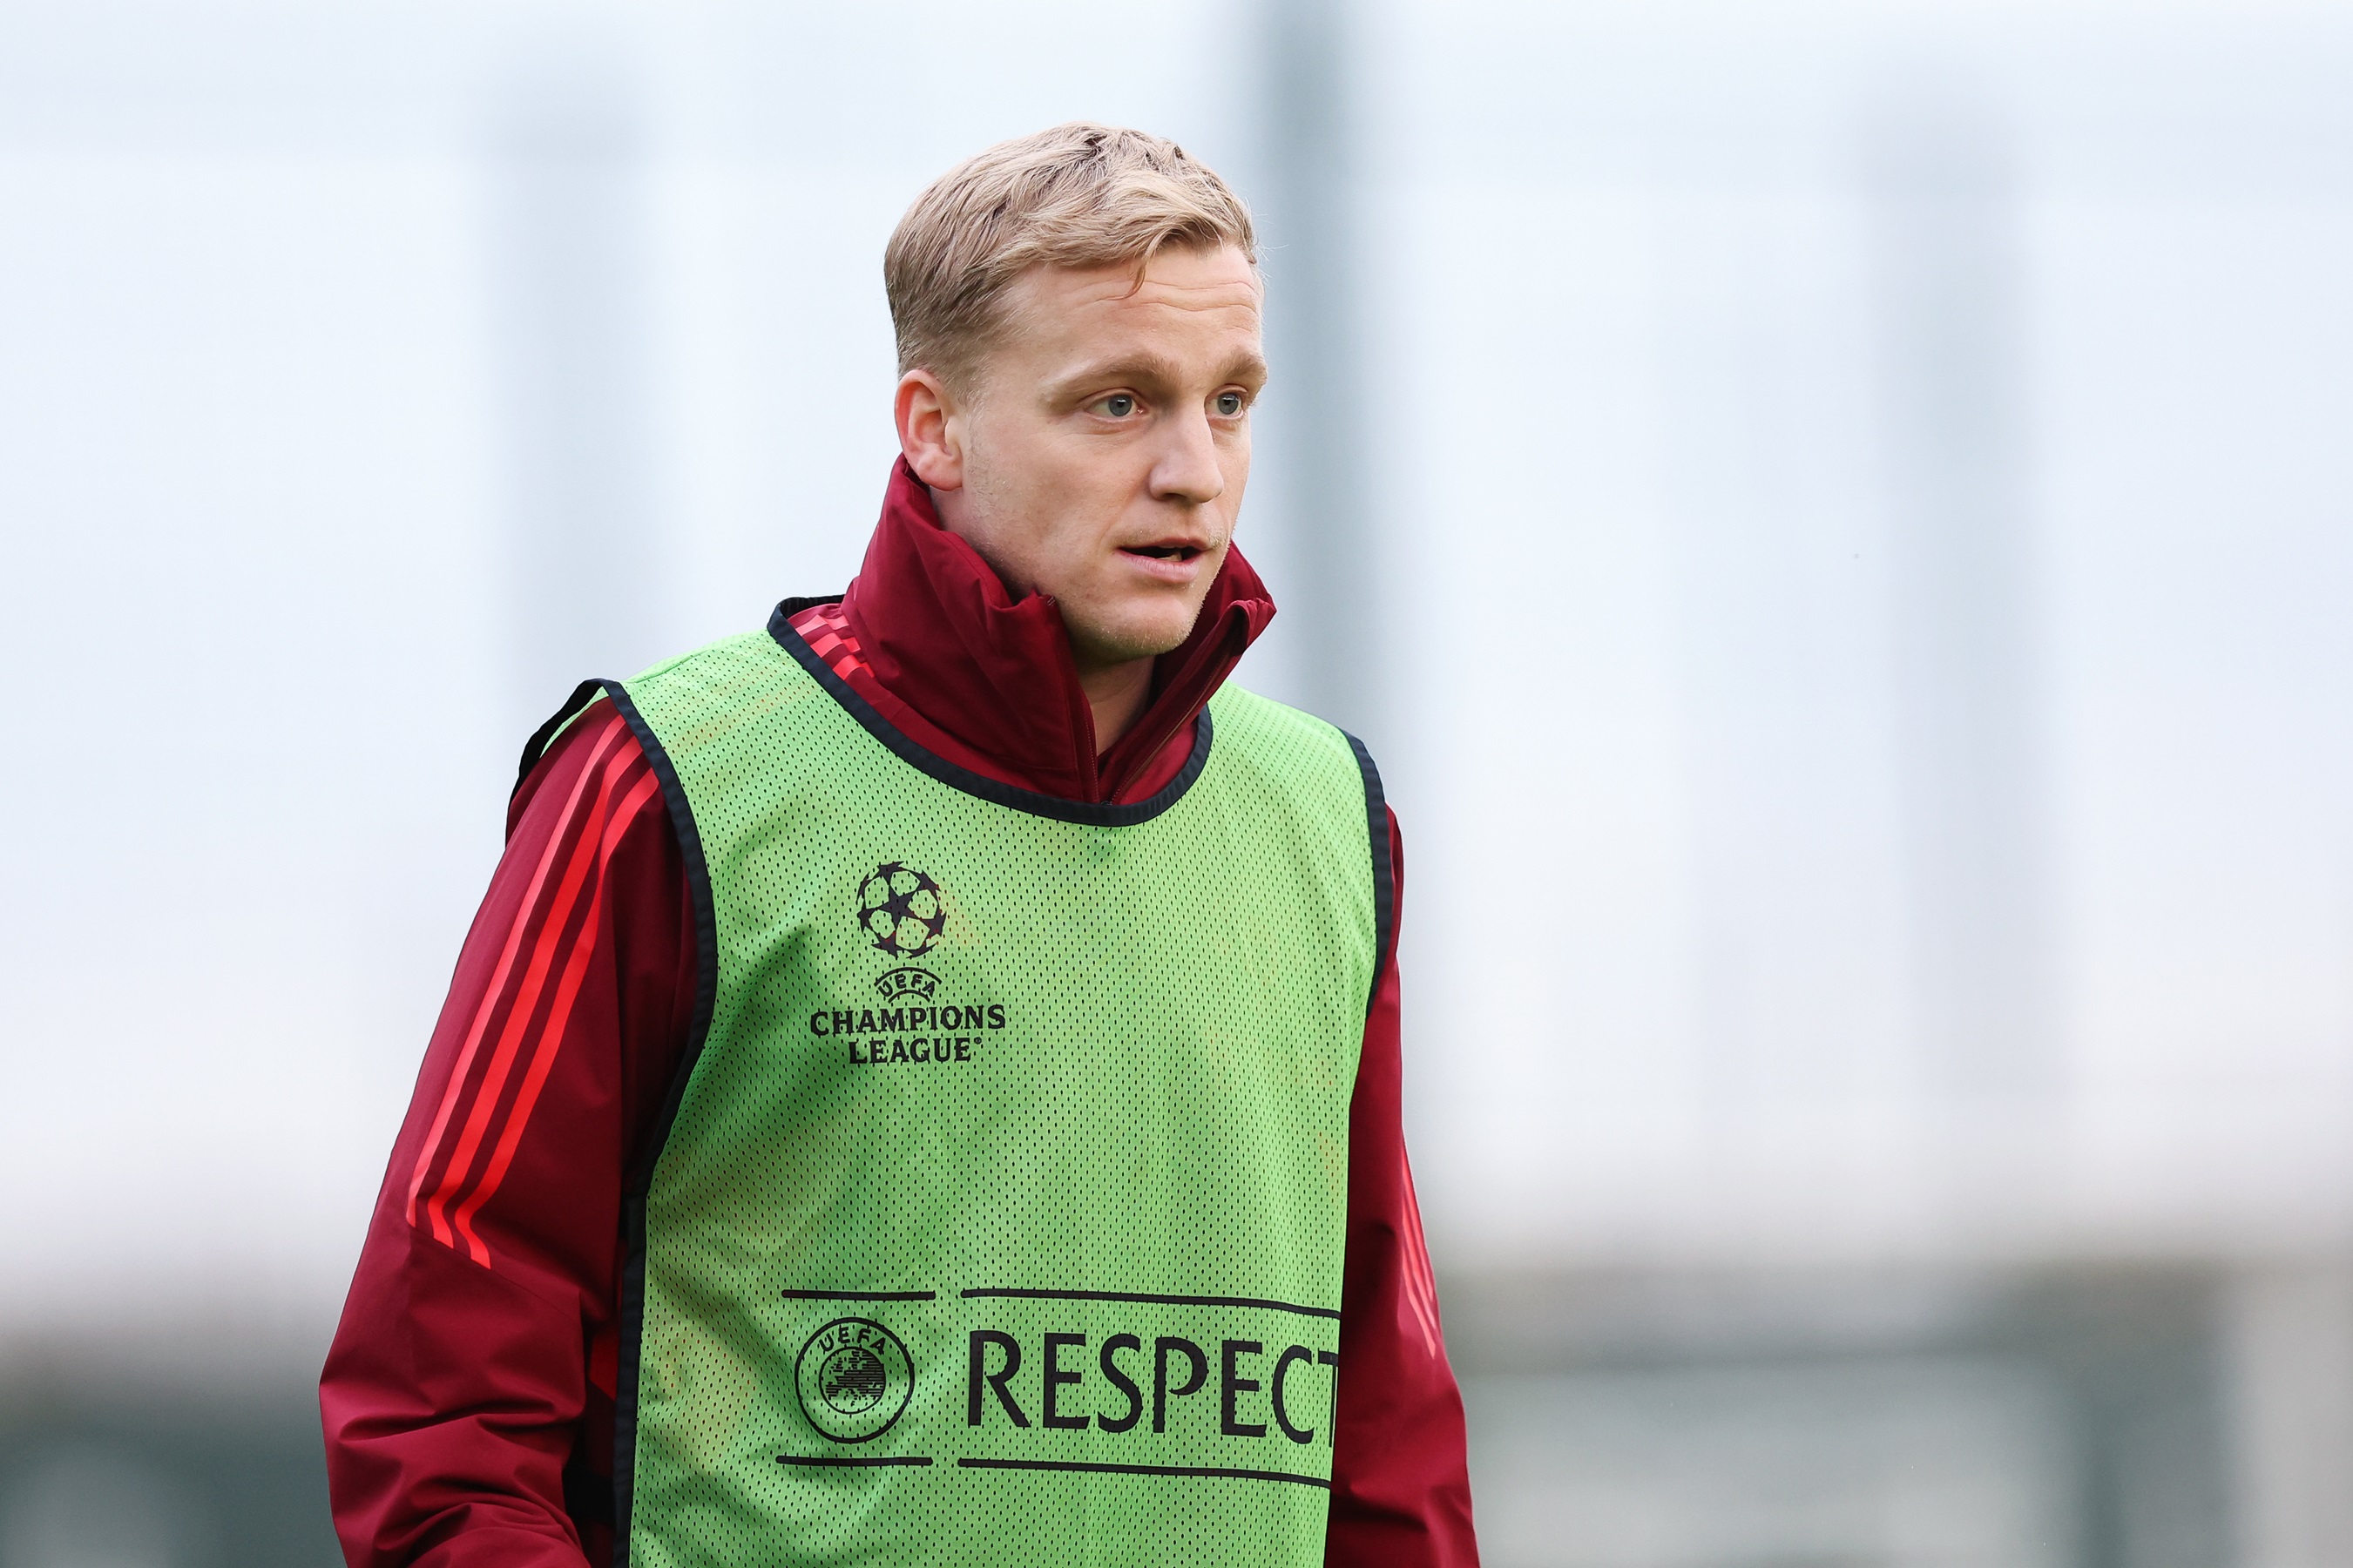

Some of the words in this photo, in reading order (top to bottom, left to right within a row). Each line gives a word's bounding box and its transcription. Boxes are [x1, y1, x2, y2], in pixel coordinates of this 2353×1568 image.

[877, 973, 936, 998] UEFA
[810, 1004, 1005, 1036] CHAMPIONS
[819, 1326, 886, 1355] UEFA
